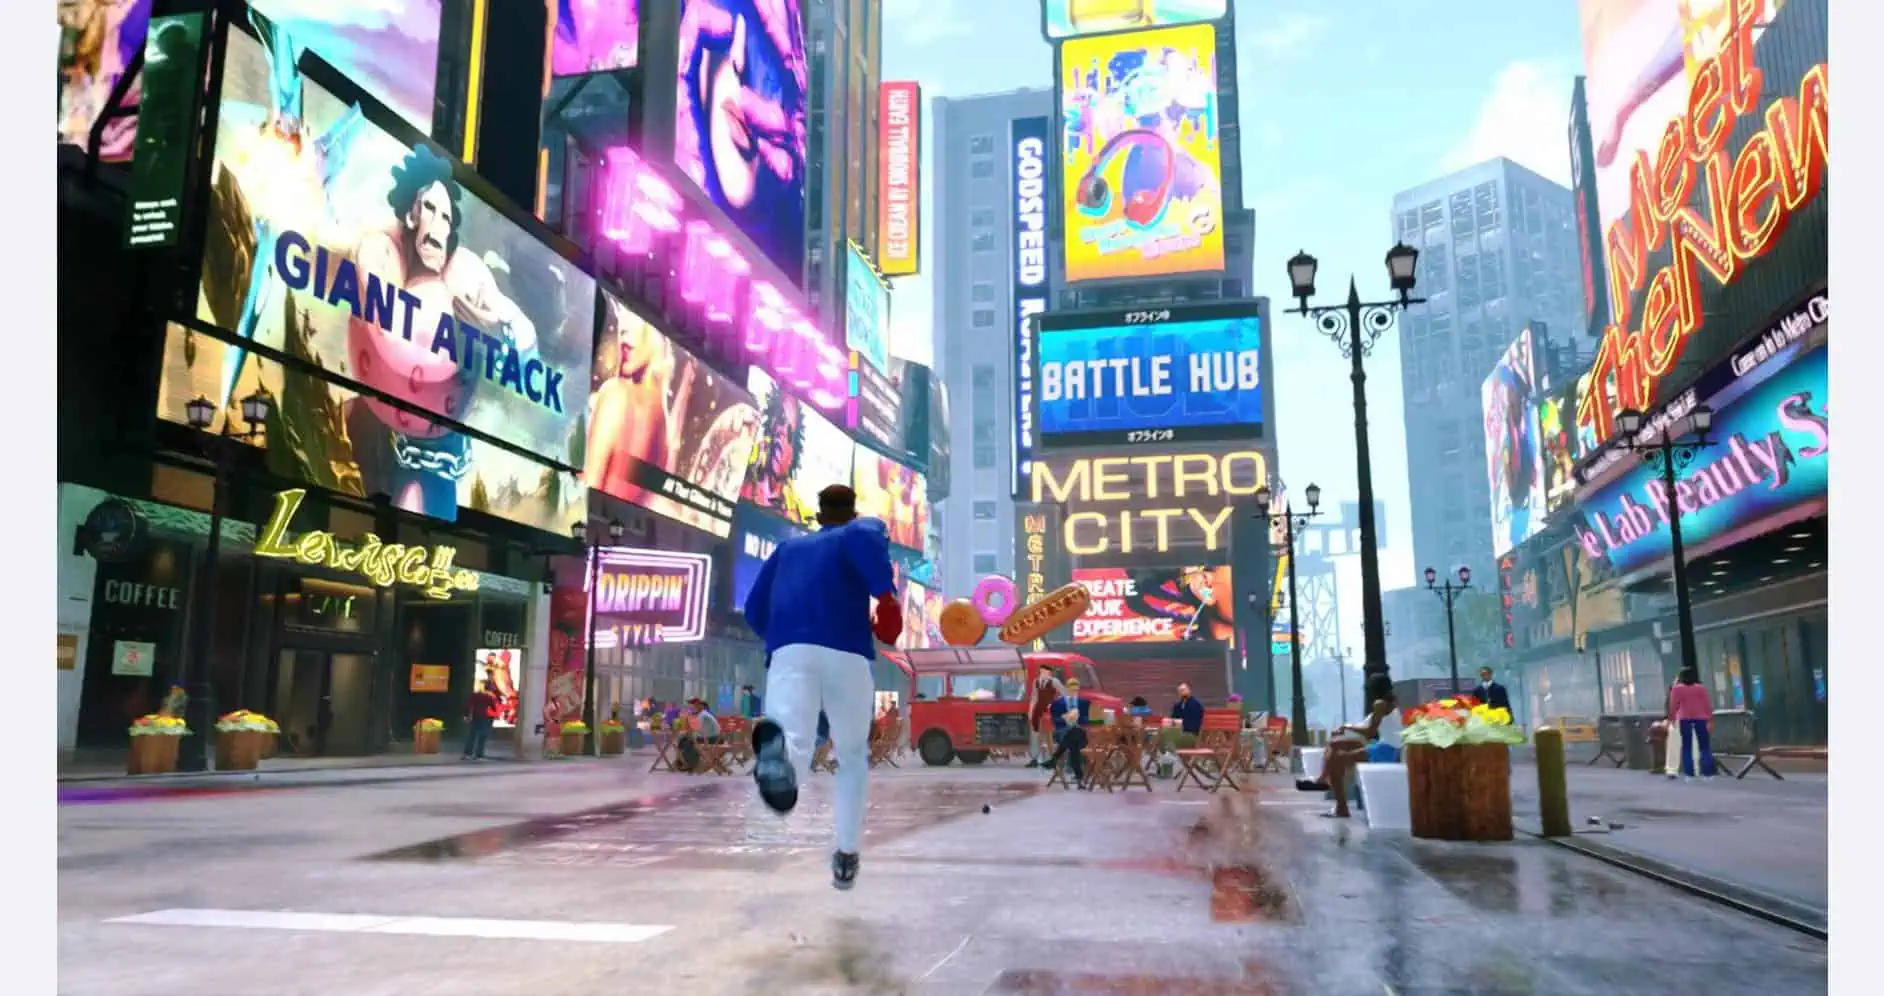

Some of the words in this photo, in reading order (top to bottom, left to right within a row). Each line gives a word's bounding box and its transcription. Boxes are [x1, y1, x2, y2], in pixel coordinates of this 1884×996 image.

[1607, 0, 1760, 325] Meet
[1018, 136, 1045, 286] GODSPEED
[274, 230, 421, 342] GIANT
[430, 313, 566, 414] ATTACK
[1042, 355, 1172, 401] BATTLE
[1188, 350, 1260, 393] HUB
[1576, 264, 1684, 441] The
[1031, 451, 1266, 503] METRO
[1594, 494, 1651, 549] Lab
[1644, 434, 1784, 524] Beauty
[1777, 395, 1827, 458] S
[255, 488, 404, 586] Lewis
[1064, 506, 1234, 554] CITY
[105, 579, 182, 610] COFFEE
[1080, 579, 1138, 597] REATE
[1085, 599, 1123, 617] OUR
[1073, 617, 1173, 637] EXPERIENCE
